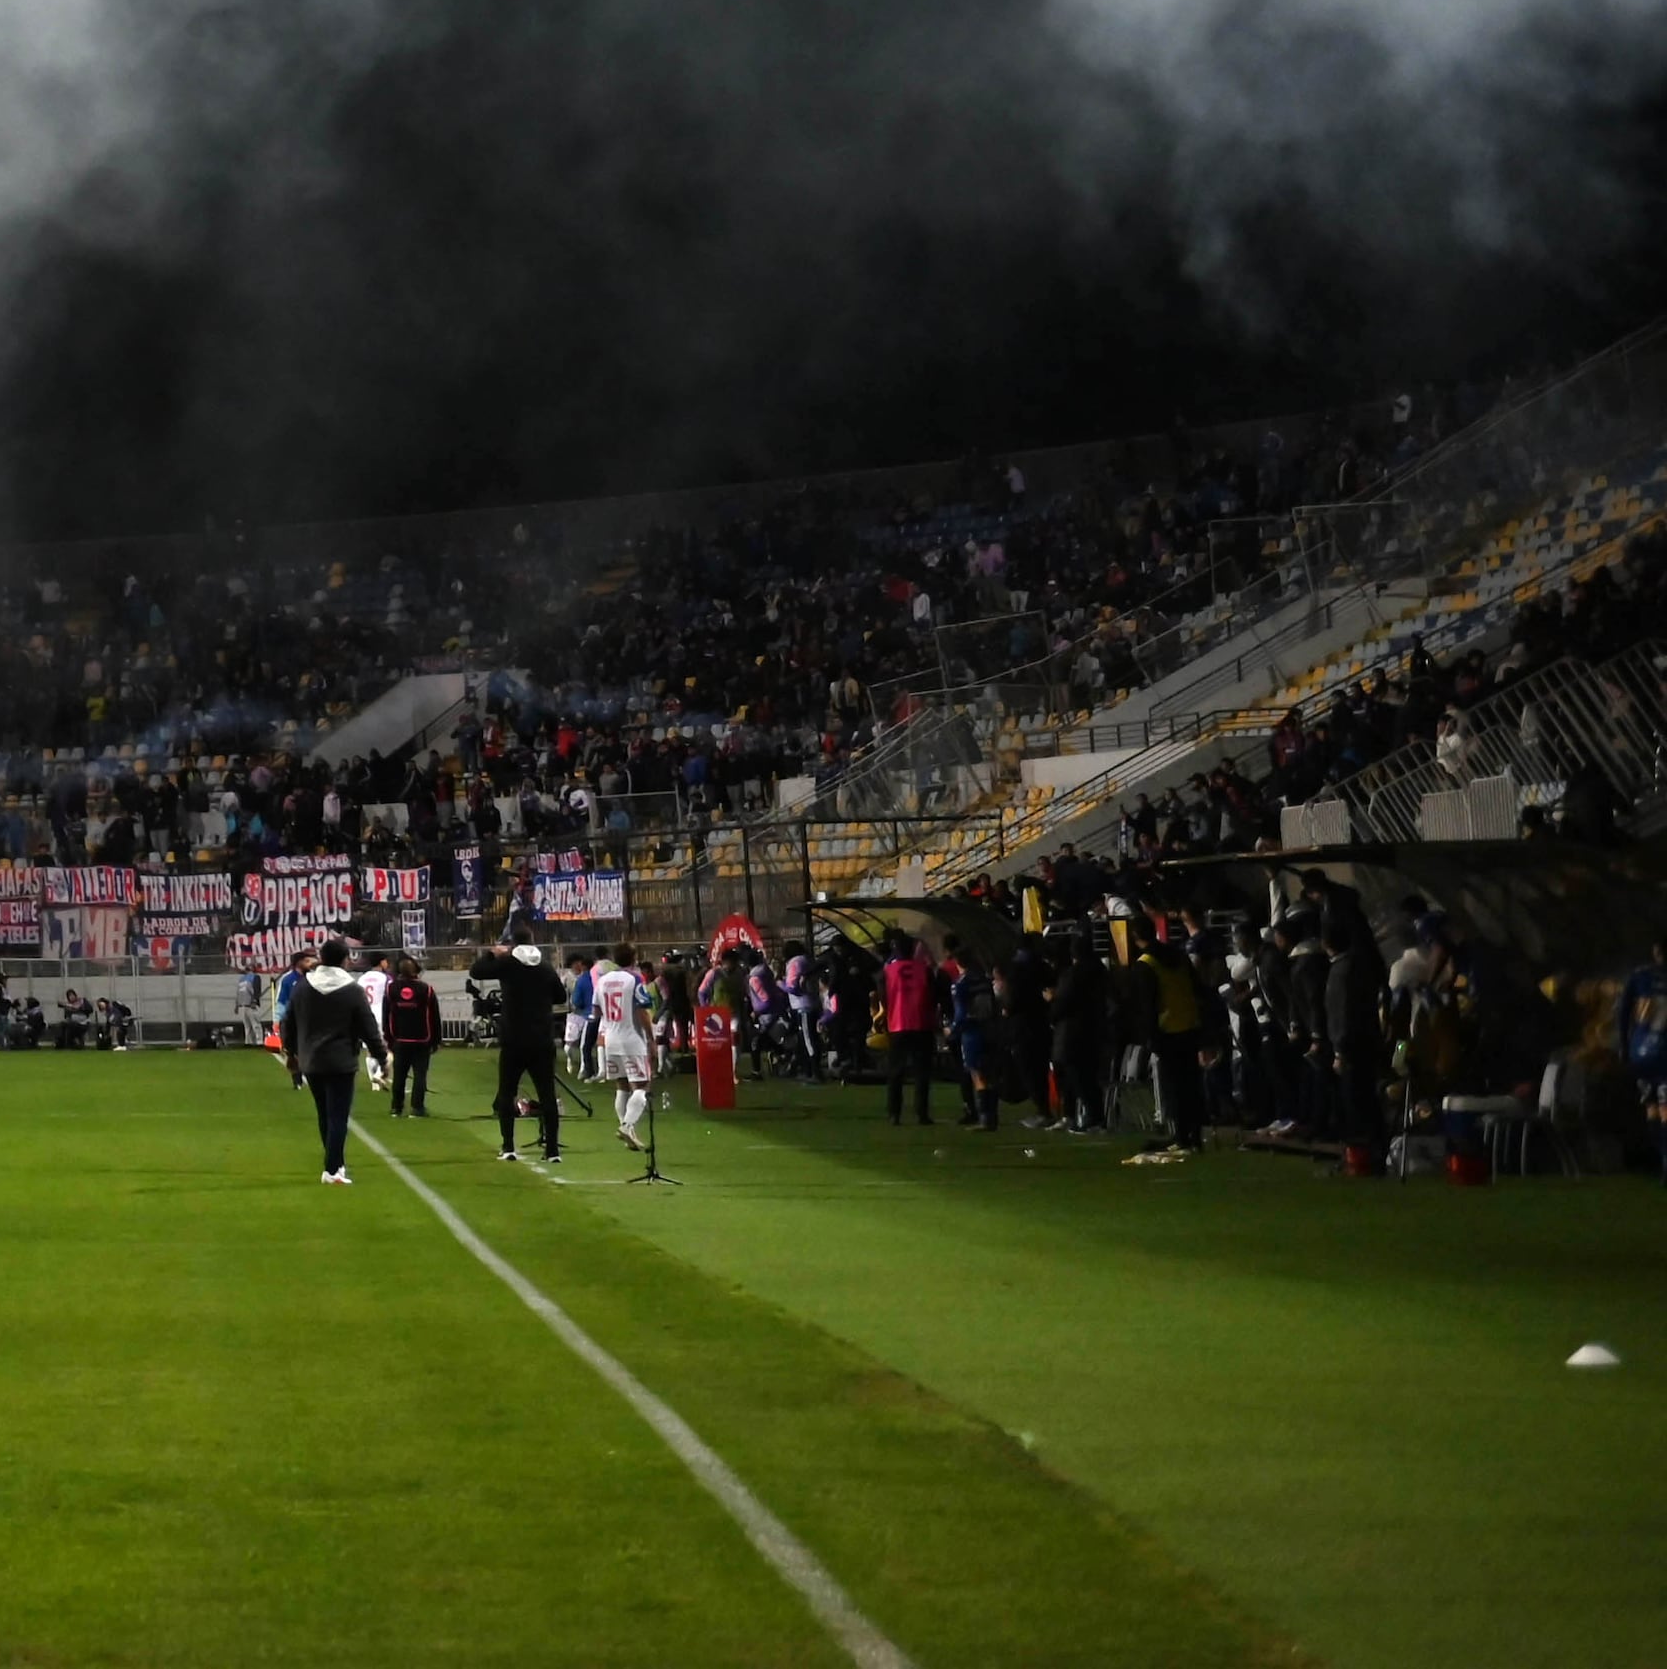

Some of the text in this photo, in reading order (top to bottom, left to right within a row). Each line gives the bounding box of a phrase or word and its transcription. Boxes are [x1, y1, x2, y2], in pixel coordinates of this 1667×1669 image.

[63, 868, 135, 904] VALLEDOR
[140, 872, 232, 912] THE INKIETOS
[264, 872, 352, 926] PIPEÑOS
